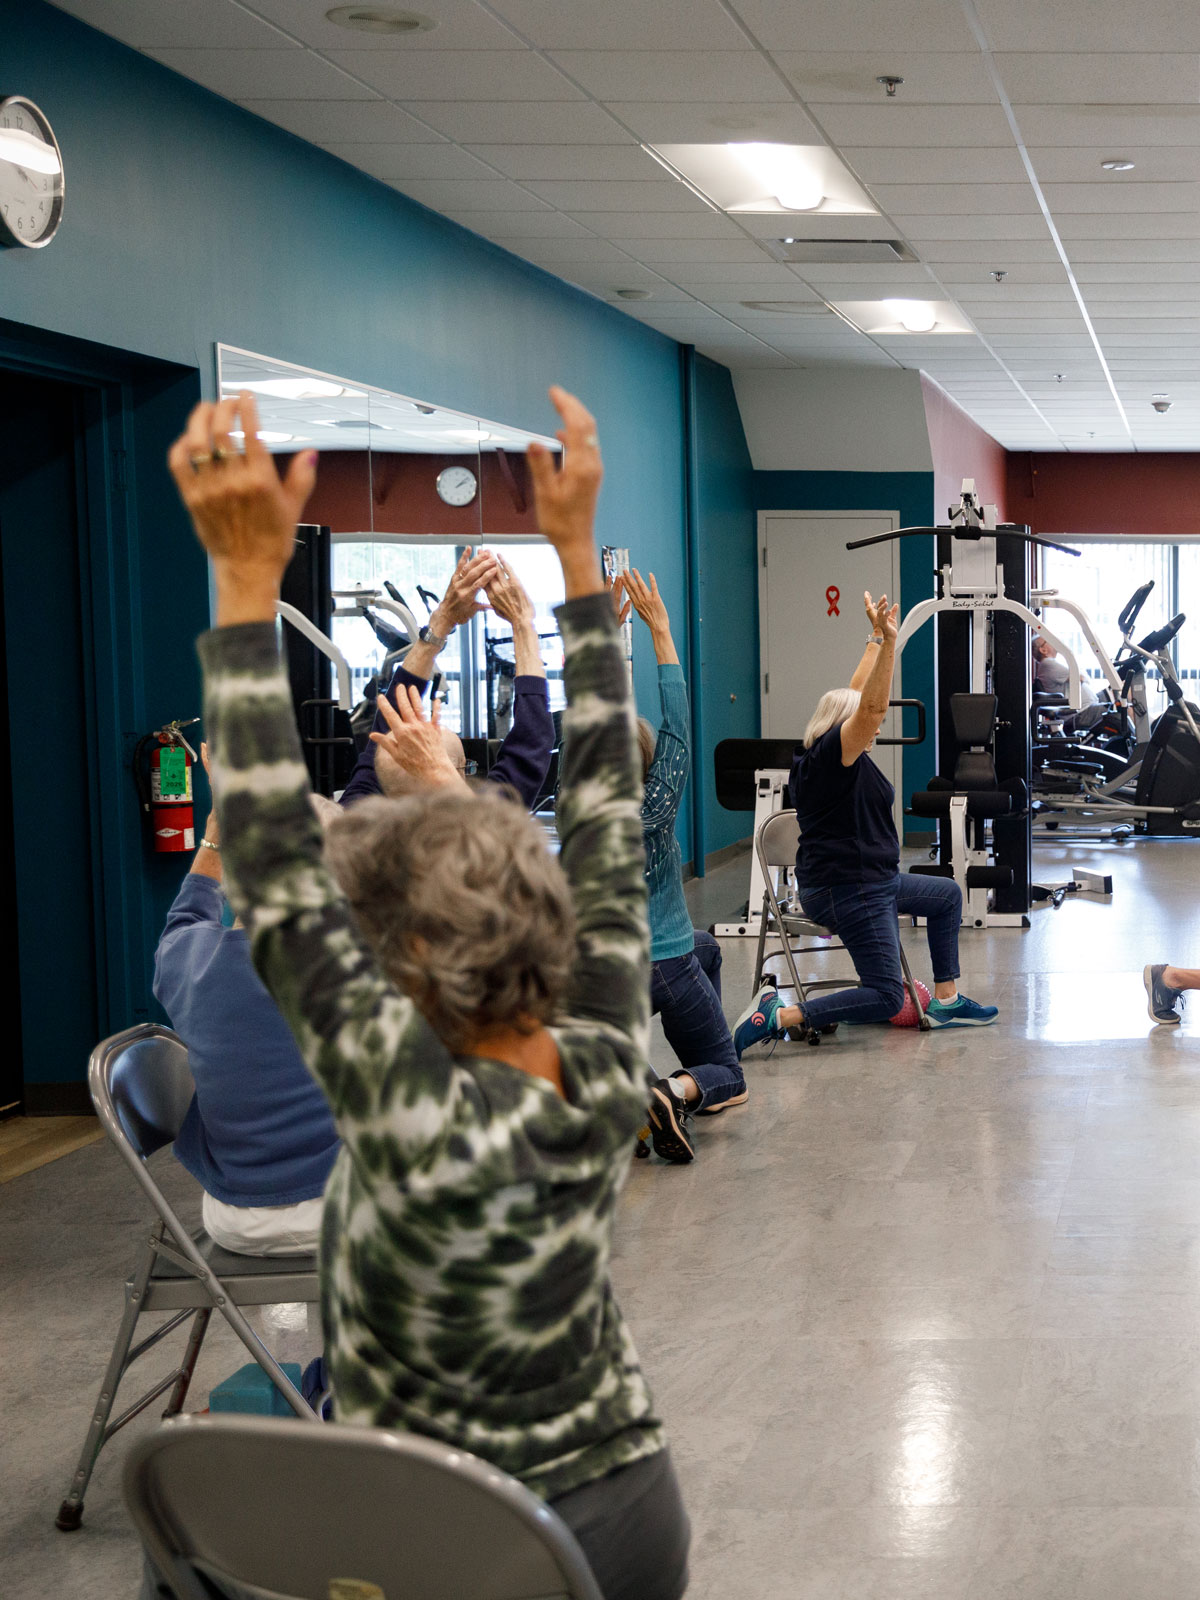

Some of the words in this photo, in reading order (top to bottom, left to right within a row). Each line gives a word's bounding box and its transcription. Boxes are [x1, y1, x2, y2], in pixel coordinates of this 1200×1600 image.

[16, 116, 24, 130] 12
[43, 179, 48, 191] 3
[4, 204, 9, 216] 7
[39, 201, 44, 212] 4
[17, 217, 23, 229] 6
[30, 216, 35, 229] 5
